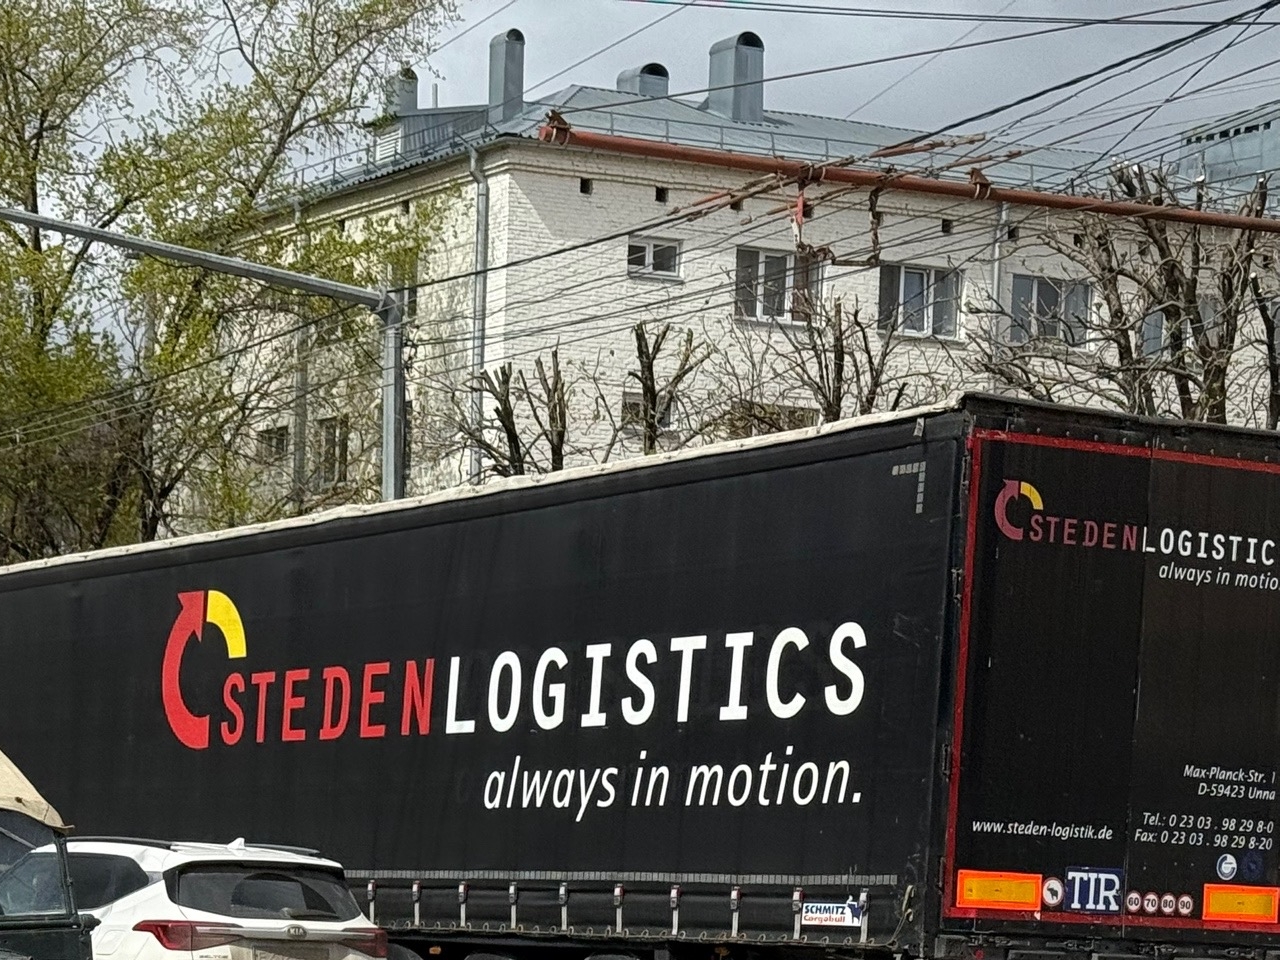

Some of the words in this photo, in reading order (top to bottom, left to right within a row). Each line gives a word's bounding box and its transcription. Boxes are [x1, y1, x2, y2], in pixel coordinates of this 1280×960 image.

[1158, 561, 1213, 587] always
[1216, 566, 1231, 586] in
[1235, 572, 1280, 591] motio
[1183, 764, 1267, 784] Max-Planck-Str.
[483, 755, 618, 823] always
[630, 751, 668, 808] in
[685, 746, 863, 809] motion.
[1197, 782, 1246, 799] D-59423
[1248, 786, 1276, 800] Unna
[972, 820, 1113, 841] www.steden-logistik.de
[1142, 812, 1166, 826] Tel.:
[1168, 814, 1177, 827] 0
[1179, 815, 1194, 828] 23
[1197, 816, 1212, 830] 03
[1221, 818, 1236, 831] 98
[1239, 819, 1254, 833] 29
[1256, 821, 1274, 834] 8-0
[1134, 828, 1158, 843] Fax:
[1160, 830, 1169, 843] 0
[1171, 831, 1186, 845] 23
[1189, 832, 1204, 846] 03
[1213, 834, 1228, 848] 98
[1231, 835, 1246, 849] 29
[1248, 836, 1273, 850] 8-20
[1068, 871, 1121, 911] TIR
[804, 905, 846, 915] SCHMITZ
[1128, 897, 1140, 906] 60
[1145, 898, 1157, 908] 70
[1162, 899, 1174, 908] 80
[1179, 900, 1191, 910] 90
[803, 914, 846, 923] Cargobull
[289, 927, 306, 936] KIA
